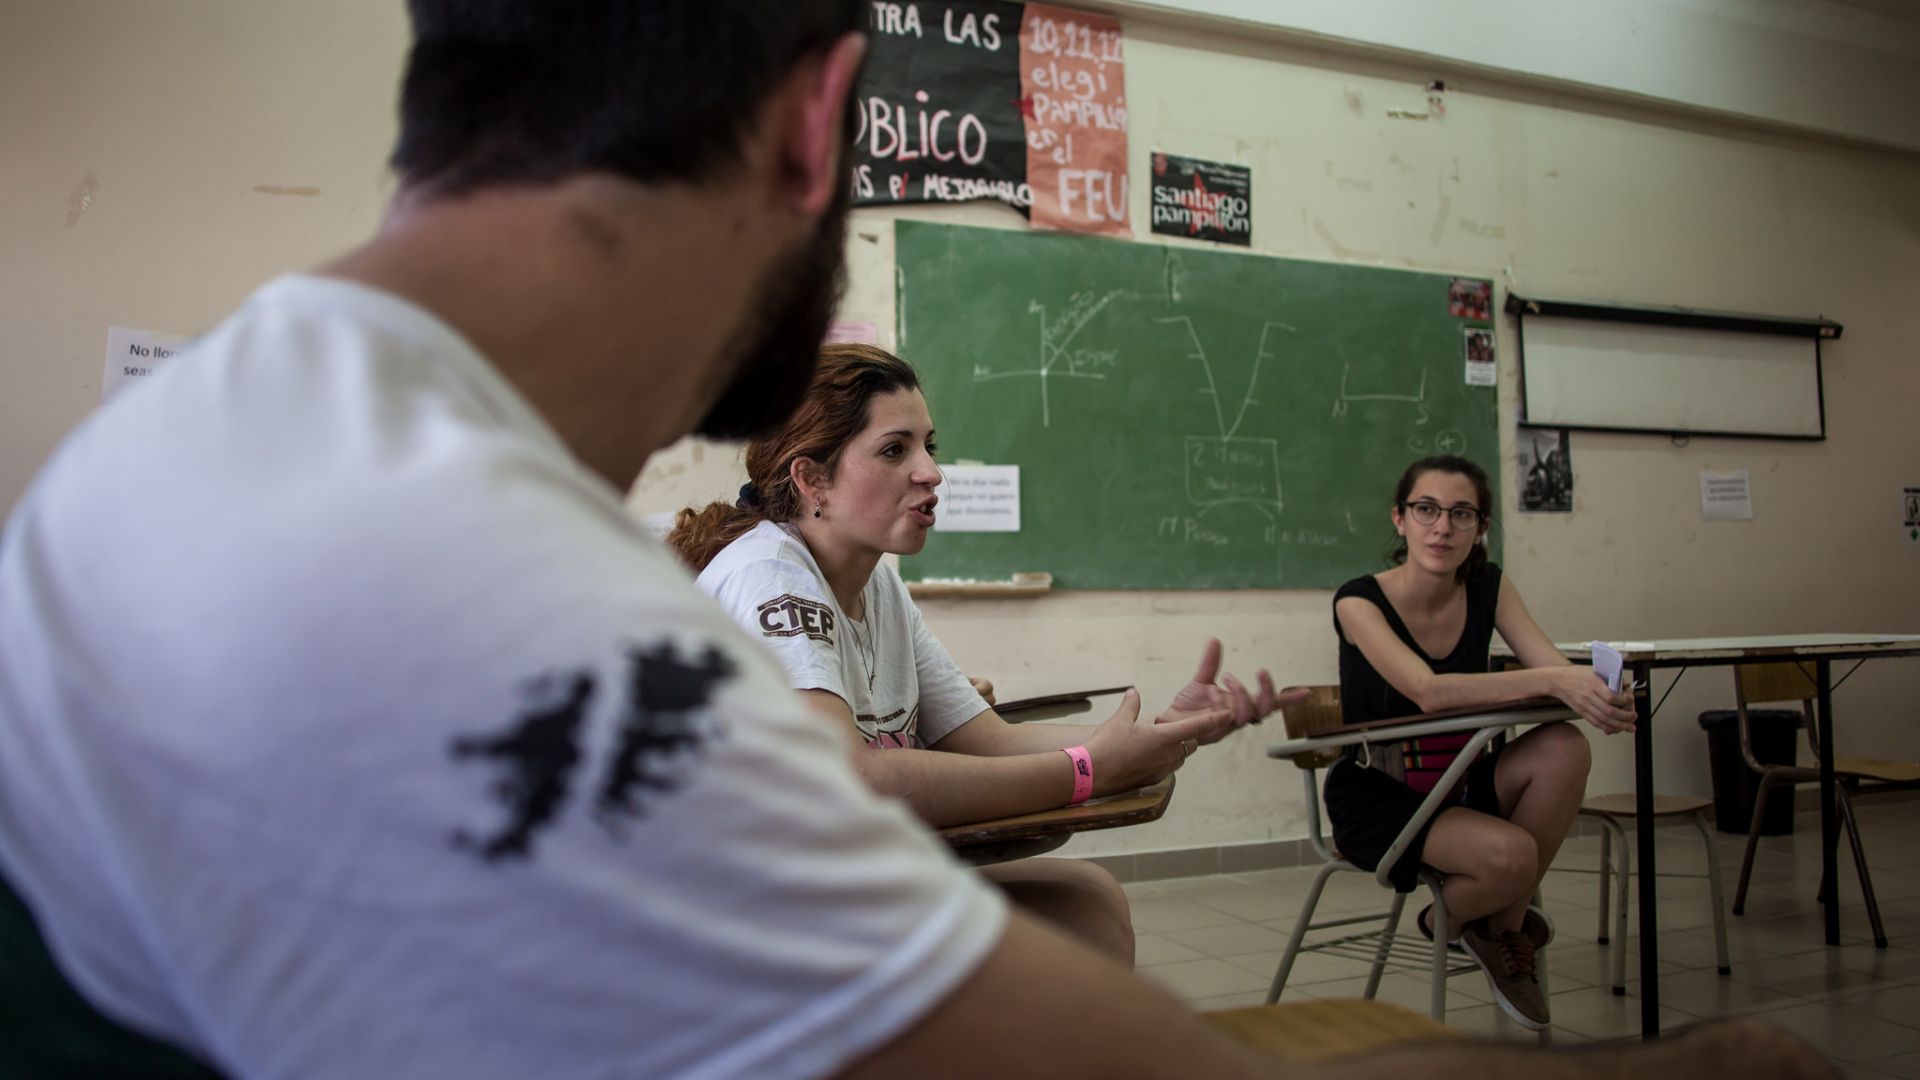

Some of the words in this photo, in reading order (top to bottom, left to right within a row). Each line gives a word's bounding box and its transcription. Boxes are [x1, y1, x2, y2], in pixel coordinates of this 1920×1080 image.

[944, 8, 1001, 51] LAS
[1058, 168, 1127, 222] FEU
[1154, 186, 1248, 218] santiago
[129, 344, 150, 358] No
[759, 600, 834, 635] CTEP
